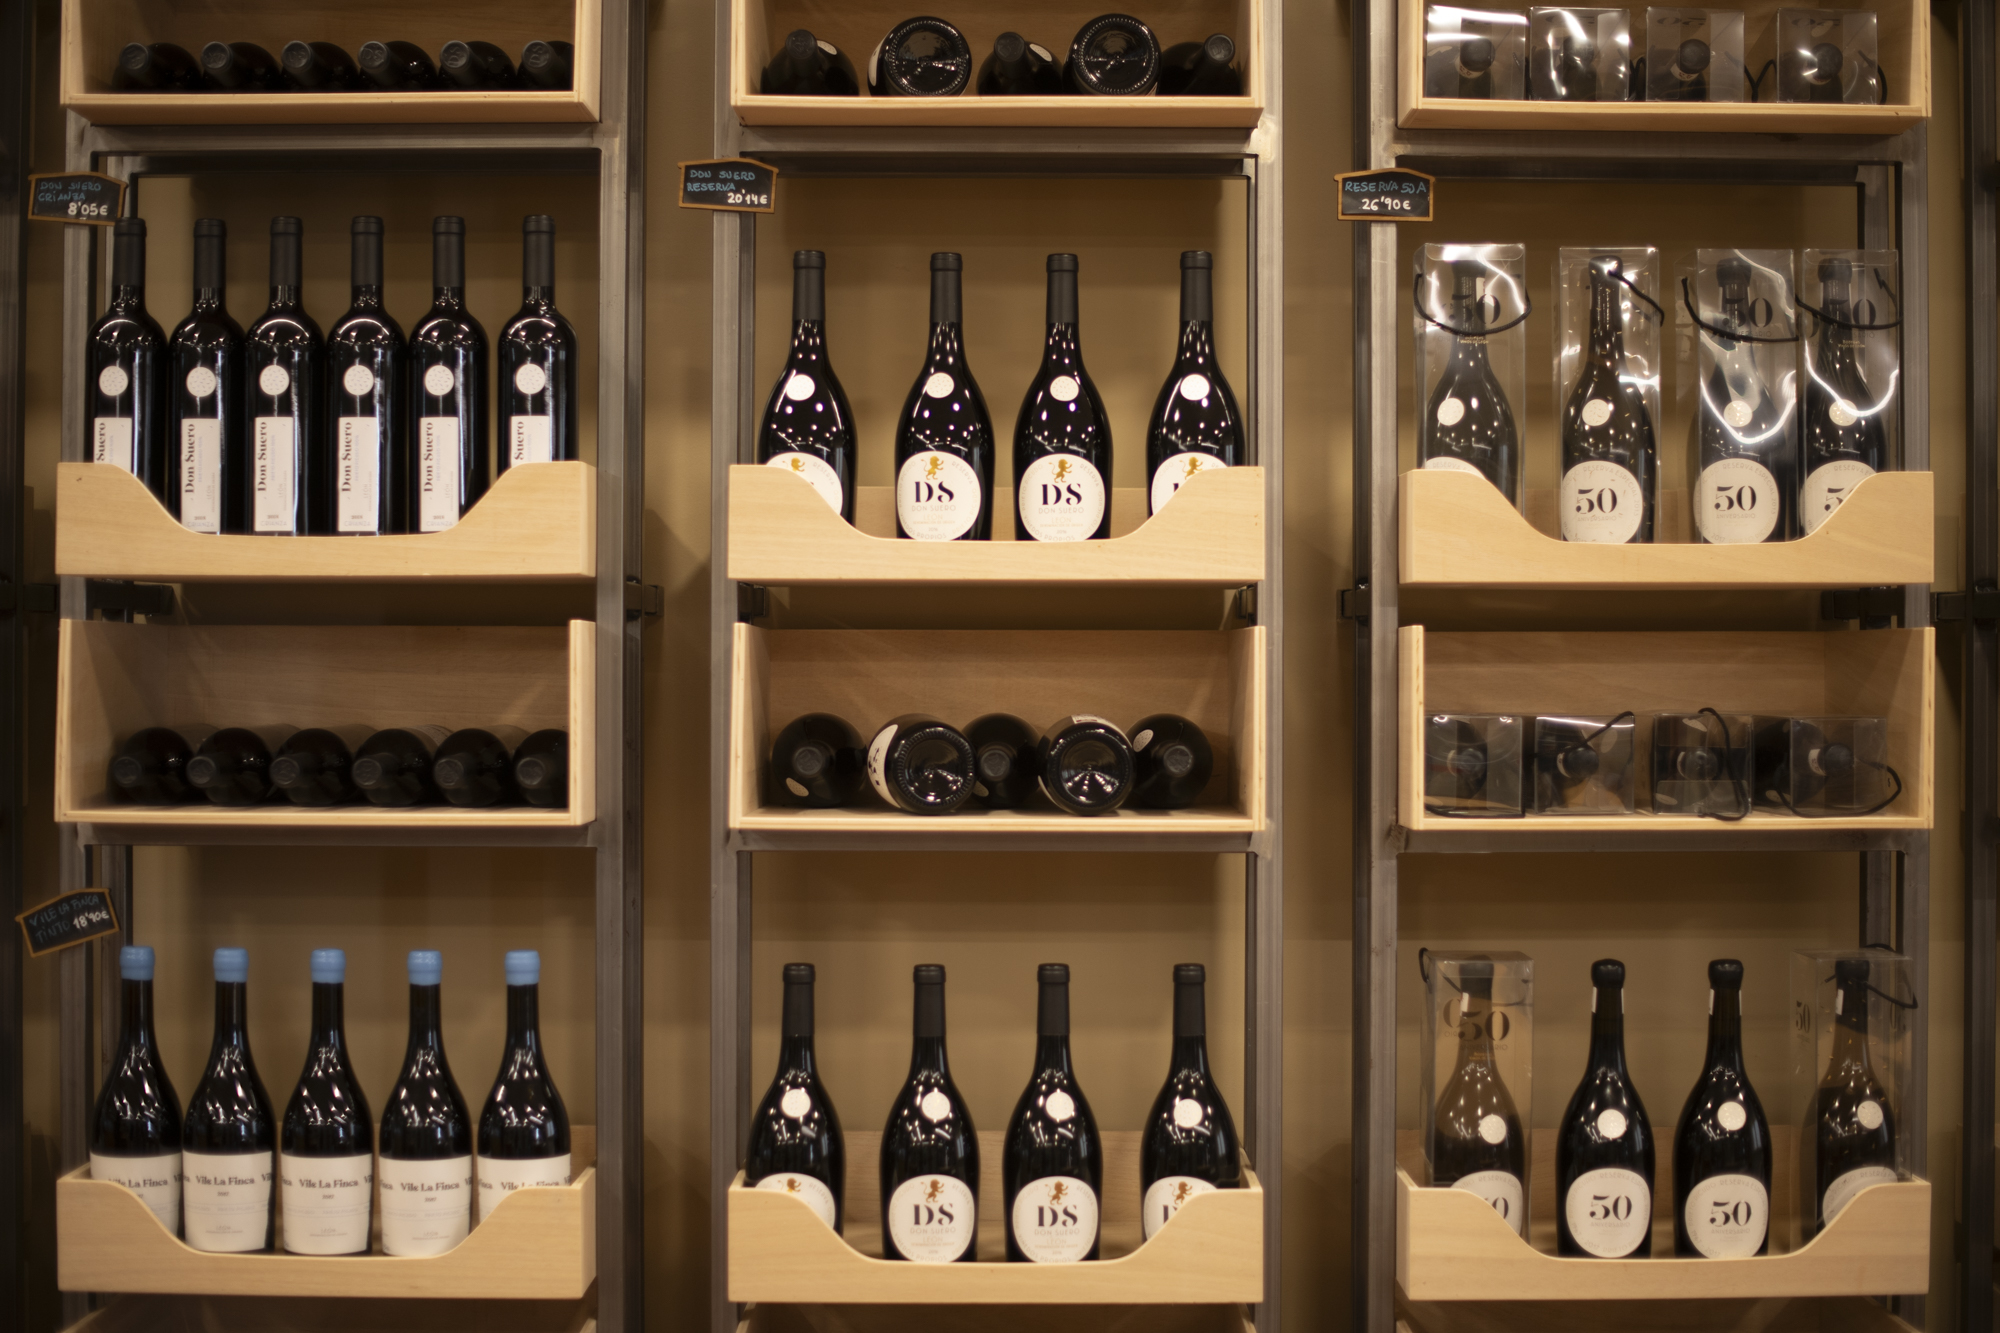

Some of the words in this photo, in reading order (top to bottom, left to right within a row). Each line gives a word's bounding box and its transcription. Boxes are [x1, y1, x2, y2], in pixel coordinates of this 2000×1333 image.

[40, 181, 62, 190] DON
[68, 181, 101, 191] SUERO
[687, 182, 736, 192] RESERVA
[690, 169, 712, 178] DON
[719, 170, 755, 181] SUERO
[1345, 181, 1399, 192] RESERVA
[97, 422, 107, 462] Suero
[186, 423, 196, 463] Suero
[258, 421, 268, 461] Suero
[342, 422, 353, 461] Suero
[424, 422, 434, 461] Suero
[515, 421, 525, 460] Suero
[258, 464, 268, 491] Don
[342, 465, 352, 492] Don
[424, 465, 434, 492] Don
[1583, 465, 1614, 474] RESERVA
[1722, 462, 1753, 472] RESERVA
[1833, 464, 1864, 474] RESERVA
[186, 466, 196, 493] Don
[914, 480, 955, 503] DS
[1041, 482, 1083, 506] DS
[1575, 487, 1618, 514] 50
[1714, 485, 1757, 512] 50
[930, 504, 956, 512] SUERO
[1458, 1010, 1510, 1041] 50
[128, 1178, 141, 1188] La
[143, 1177, 169, 1188] Finca
[195, 1174, 213, 1185] Vile
[213, 1175, 226, 1185] La
[228, 1174, 255, 1186] Finca
[299, 1178, 318, 1189] Vile
[318, 1179, 331, 1189] La
[333, 1178, 359, 1189] Finca
[400, 1182, 419, 1192] Vile
[420, 1182, 434, 1192] La
[436, 1181, 460, 1192] Finca
[913, 1202, 954, 1226] DS
[1037, 1204, 1078, 1227] DS
[1589, 1194, 1633, 1221] 50
[1709, 1200, 1752, 1227] 50
[931, 1226, 956, 1234] SUERO
[1055, 1228, 1080, 1236] SUERO
